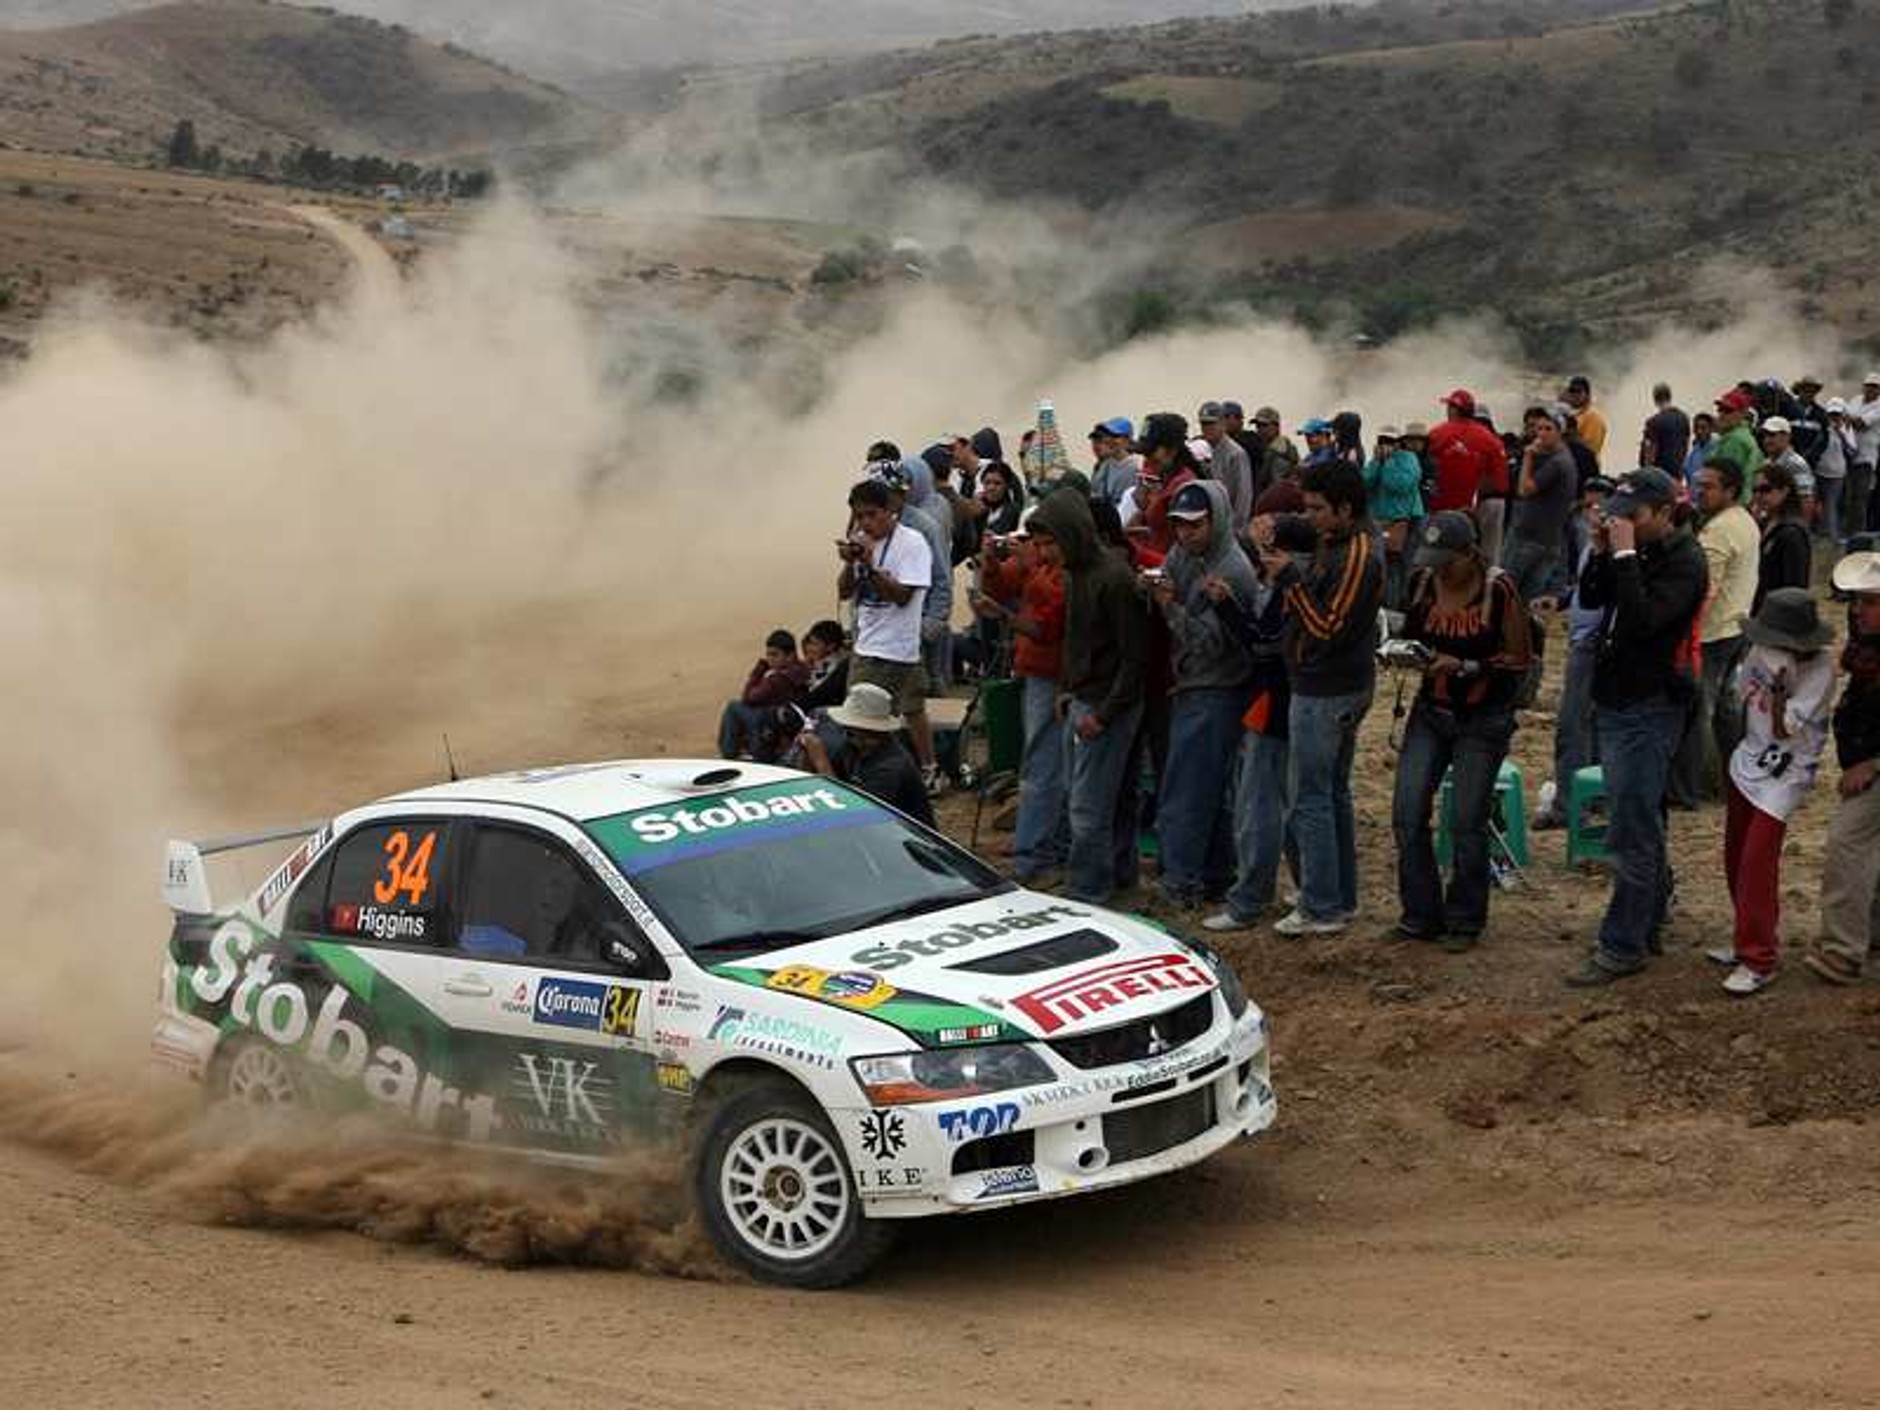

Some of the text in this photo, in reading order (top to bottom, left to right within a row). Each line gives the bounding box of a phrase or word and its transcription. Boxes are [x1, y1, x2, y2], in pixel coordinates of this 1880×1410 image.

[631, 788, 847, 842] Stobart
[375, 831, 436, 904] 34
[357, 905, 425, 938] Higgins
[851, 905, 1092, 971] Stobart
[538, 986, 600, 1016] Corona
[604, 988, 639, 1036] 34
[1010, 954, 1217, 1035] PIRELLI
[191, 919, 494, 1140] Stobart
[518, 1054, 606, 1124] VK
[938, 1102, 1021, 1141] TOP
[860, 1168, 923, 1187] IKE
